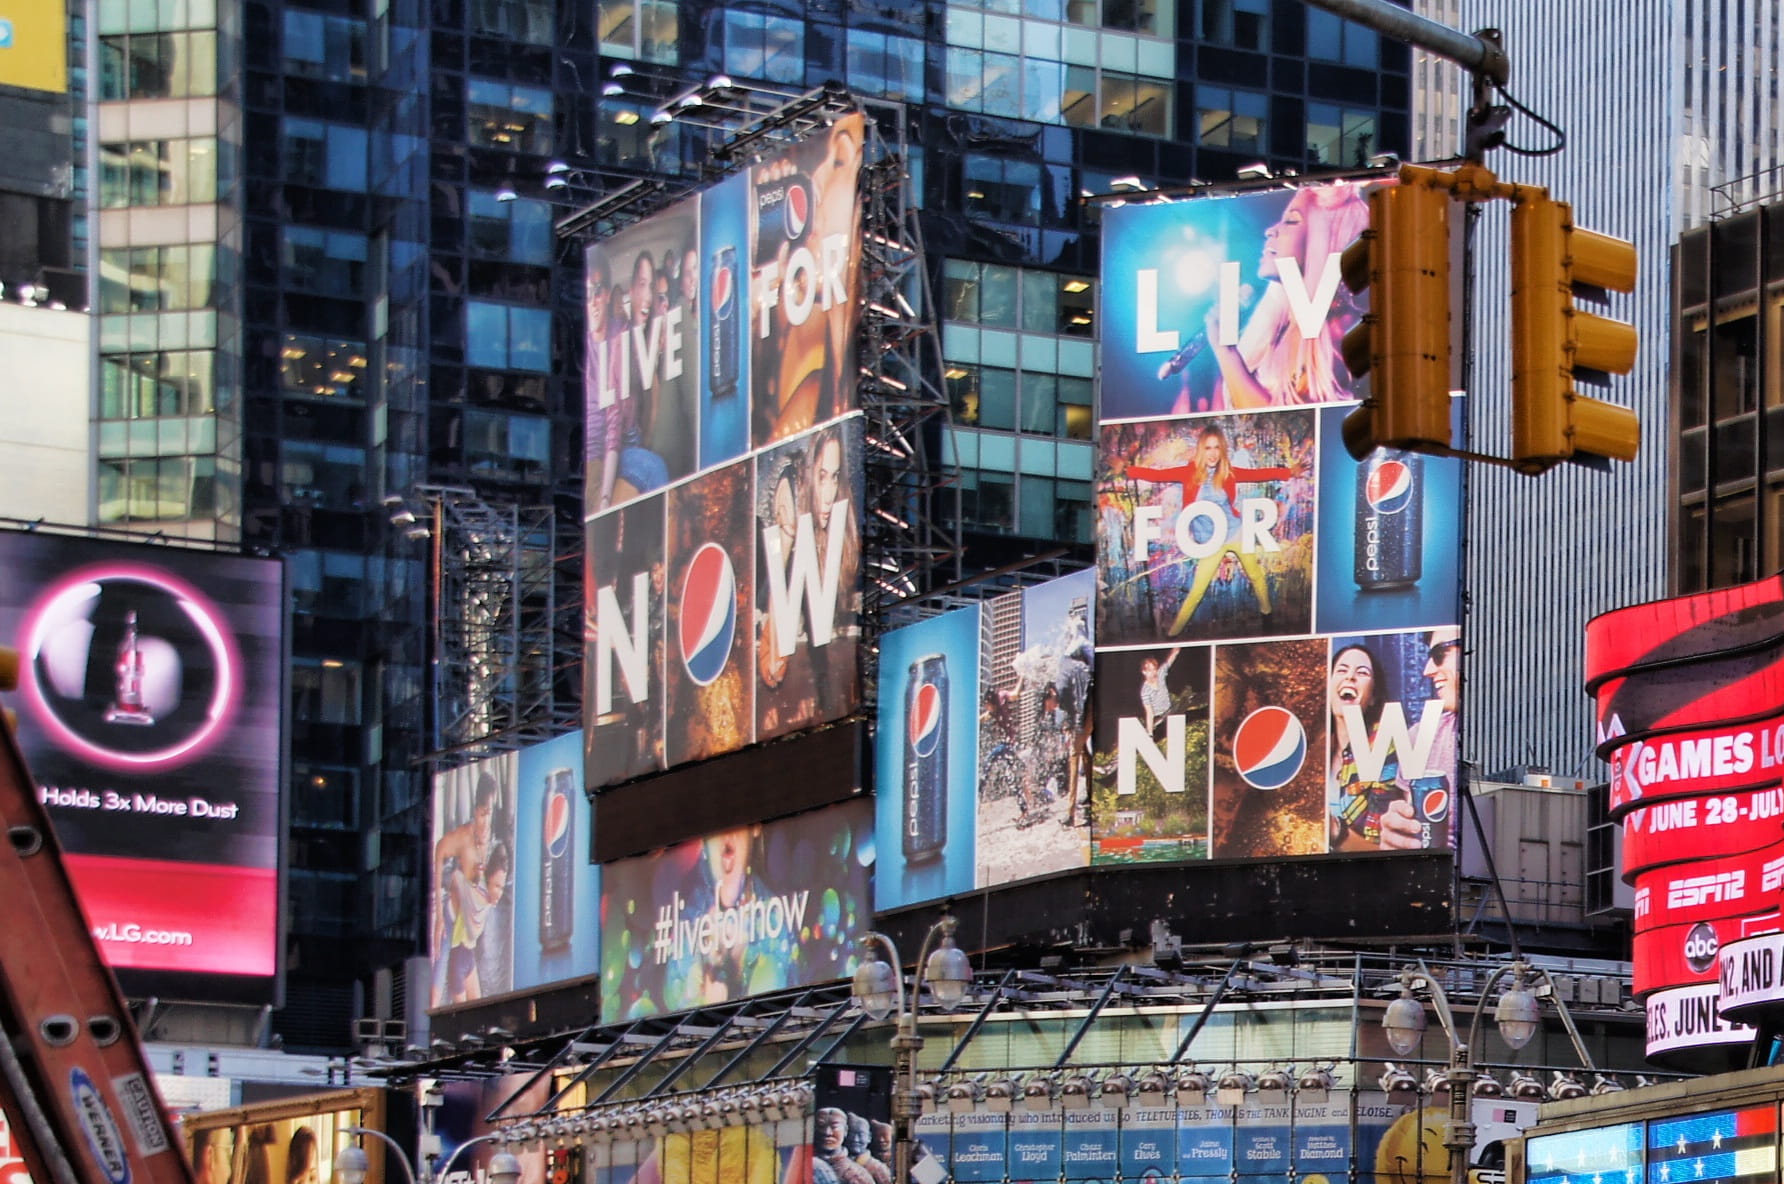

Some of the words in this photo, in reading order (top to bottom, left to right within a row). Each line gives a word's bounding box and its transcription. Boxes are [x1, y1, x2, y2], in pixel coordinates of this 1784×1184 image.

[751, 232, 849, 339] FOR
[1136, 252, 1342, 353] LIV
[598, 306, 683, 410] LIVE
[1134, 497, 1281, 562] FOR
[1366, 516, 1380, 572] pepsi
[1639, 732, 1753, 786] GAMES
[41, 787, 100, 809] Holds
[104, 790, 131, 813] 3x
[135, 796, 188, 818] More
[191, 800, 240, 821] Dust
[1649, 801, 1697, 834] JUNE
[1667, 870, 1745, 909] ESPN2
[654, 881, 810, 966] #livefornow
[1684, 933, 1718, 958] abc
[1742, 948, 1773, 993] AND
[1674, 995, 1722, 1036] JUNE
[82, 1094, 123, 1173] WERNER
[1018, 1112, 1039, 1123] who
[1103, 1112, 1115, 1123] us
[1247, 1110, 1262, 1119] THE
[1264, 1107, 1290, 1119] TANK
[1331, 1109, 1347, 1118] and
